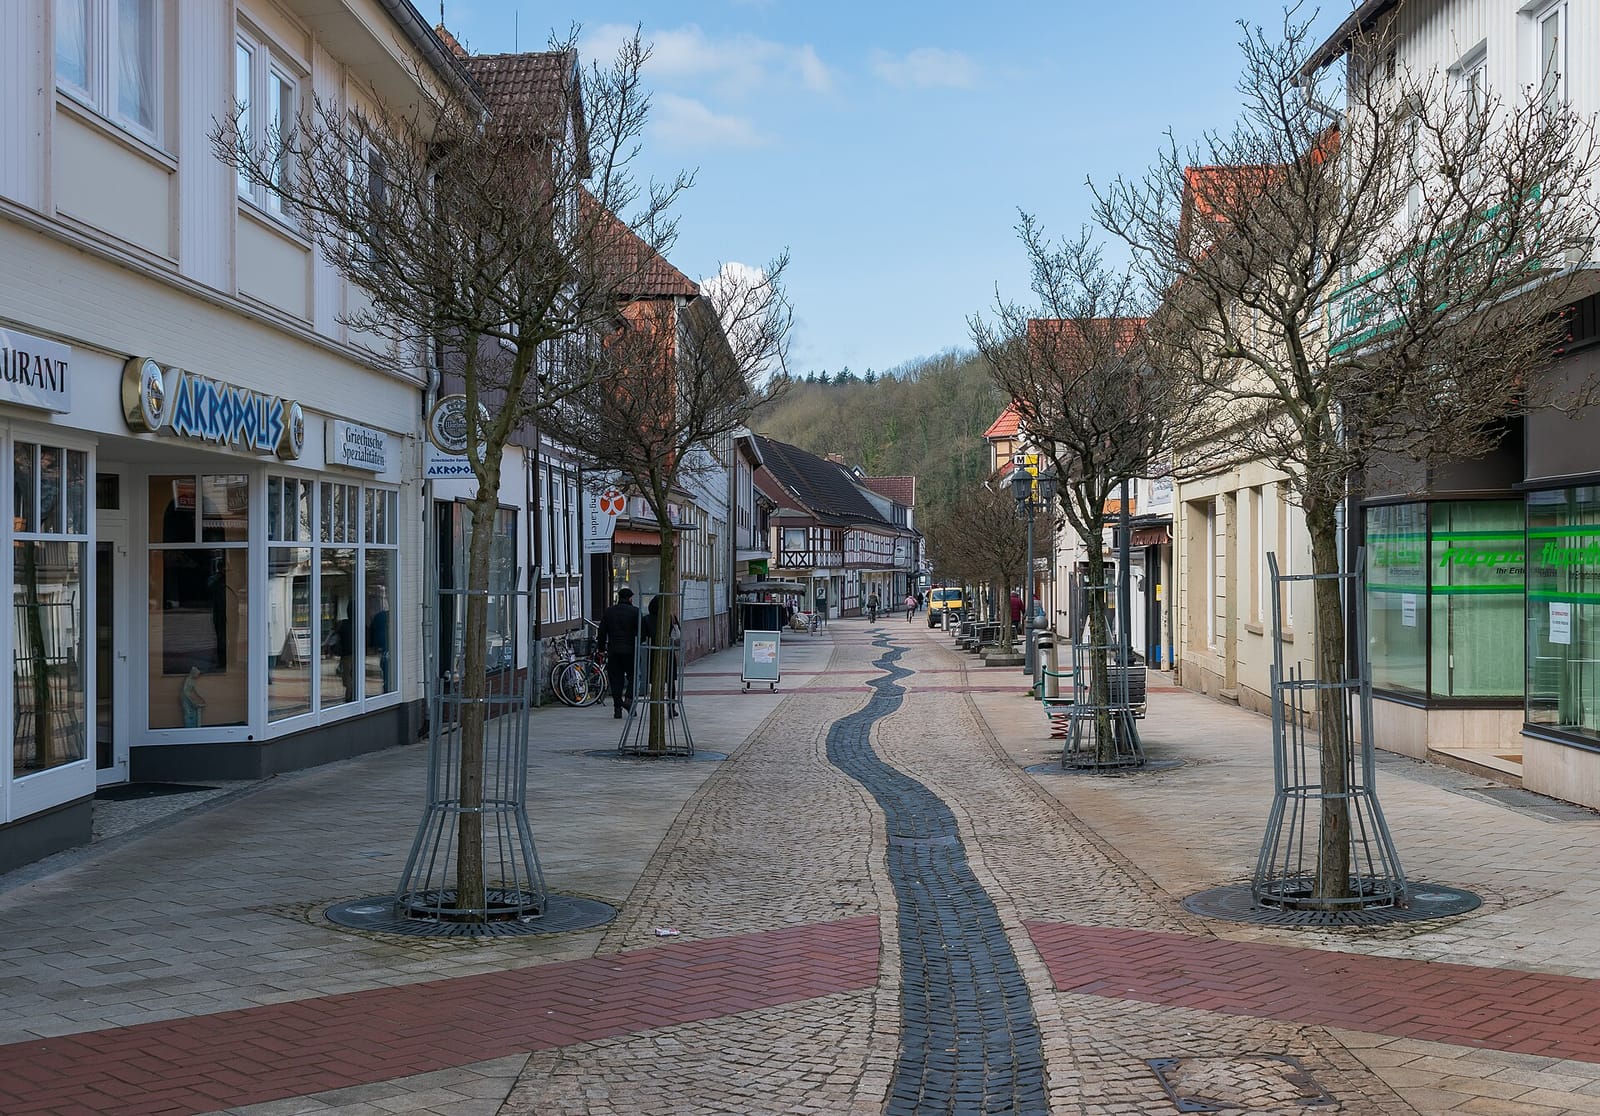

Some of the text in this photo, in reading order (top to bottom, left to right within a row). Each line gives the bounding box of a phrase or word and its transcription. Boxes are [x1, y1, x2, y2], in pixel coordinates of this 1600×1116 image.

[0, 347, 68, 393] URANT
[173, 372, 284, 452] AKROPOLIS
[345, 426, 383, 450] Griechische
[342, 443, 385, 466] Spezialitäten
[427, 466, 476, 475] AKROPOL
